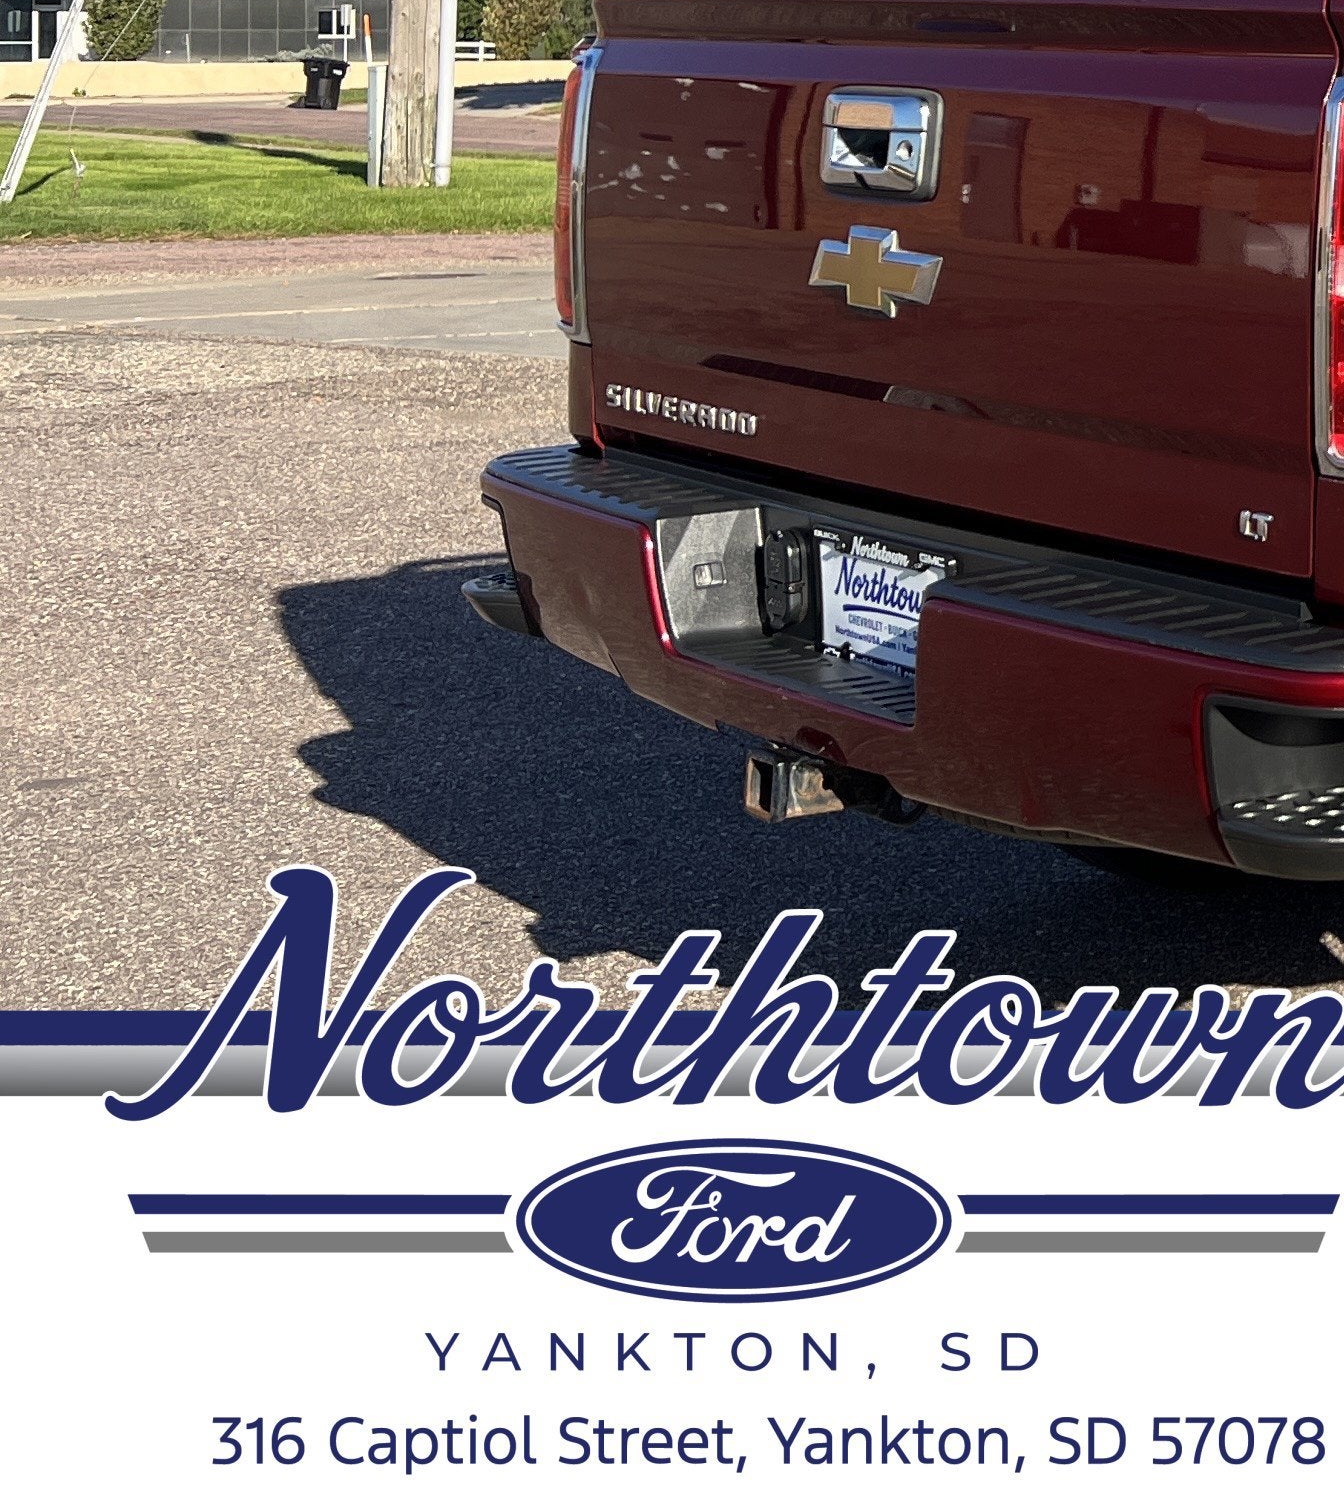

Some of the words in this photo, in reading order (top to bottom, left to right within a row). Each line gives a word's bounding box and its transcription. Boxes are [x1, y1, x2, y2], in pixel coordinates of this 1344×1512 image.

[604, 383, 758, 437] SILVERADO
[1239, 509, 1275, 542] LT
[850, 535, 911, 568] Northtown
